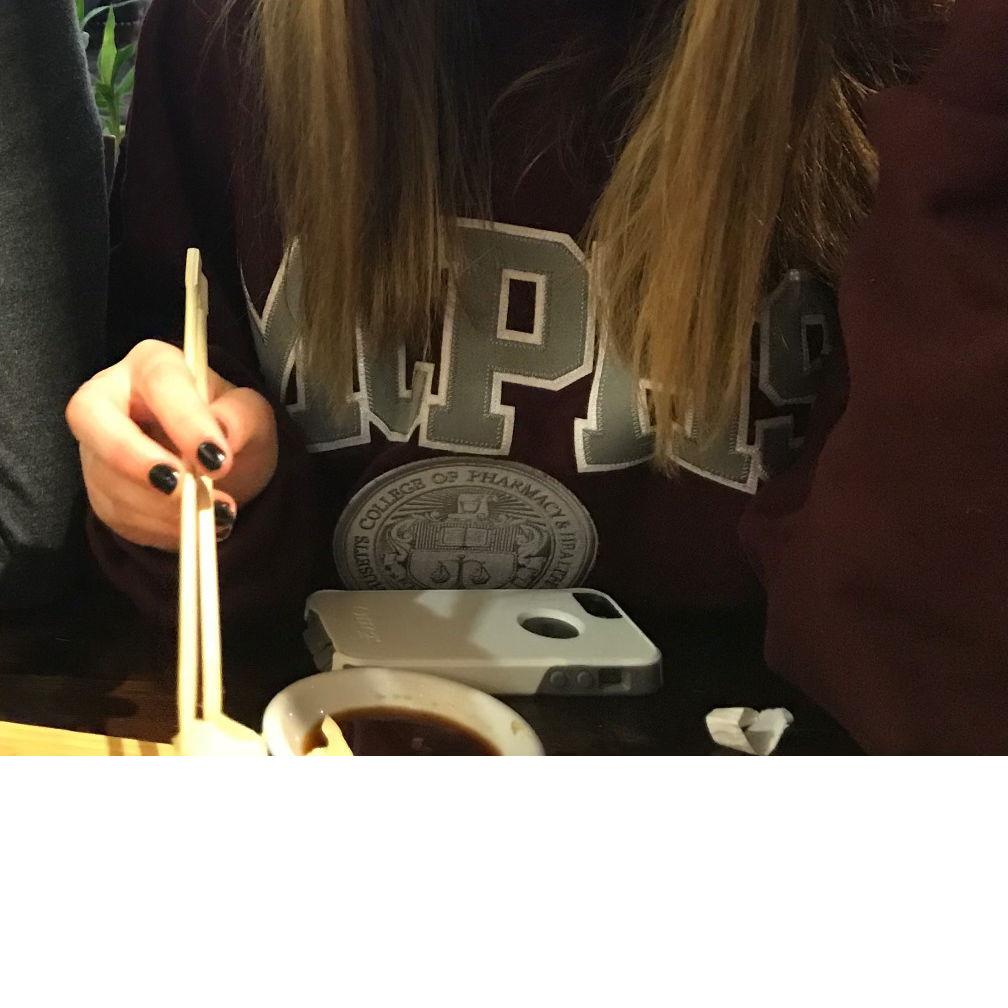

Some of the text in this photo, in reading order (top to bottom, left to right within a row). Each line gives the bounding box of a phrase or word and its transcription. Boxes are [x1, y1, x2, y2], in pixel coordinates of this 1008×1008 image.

[359, 472, 426, 530] COLLEGE
[432, 470, 459, 485] OF
[466, 469, 566, 519] PHARMACY
